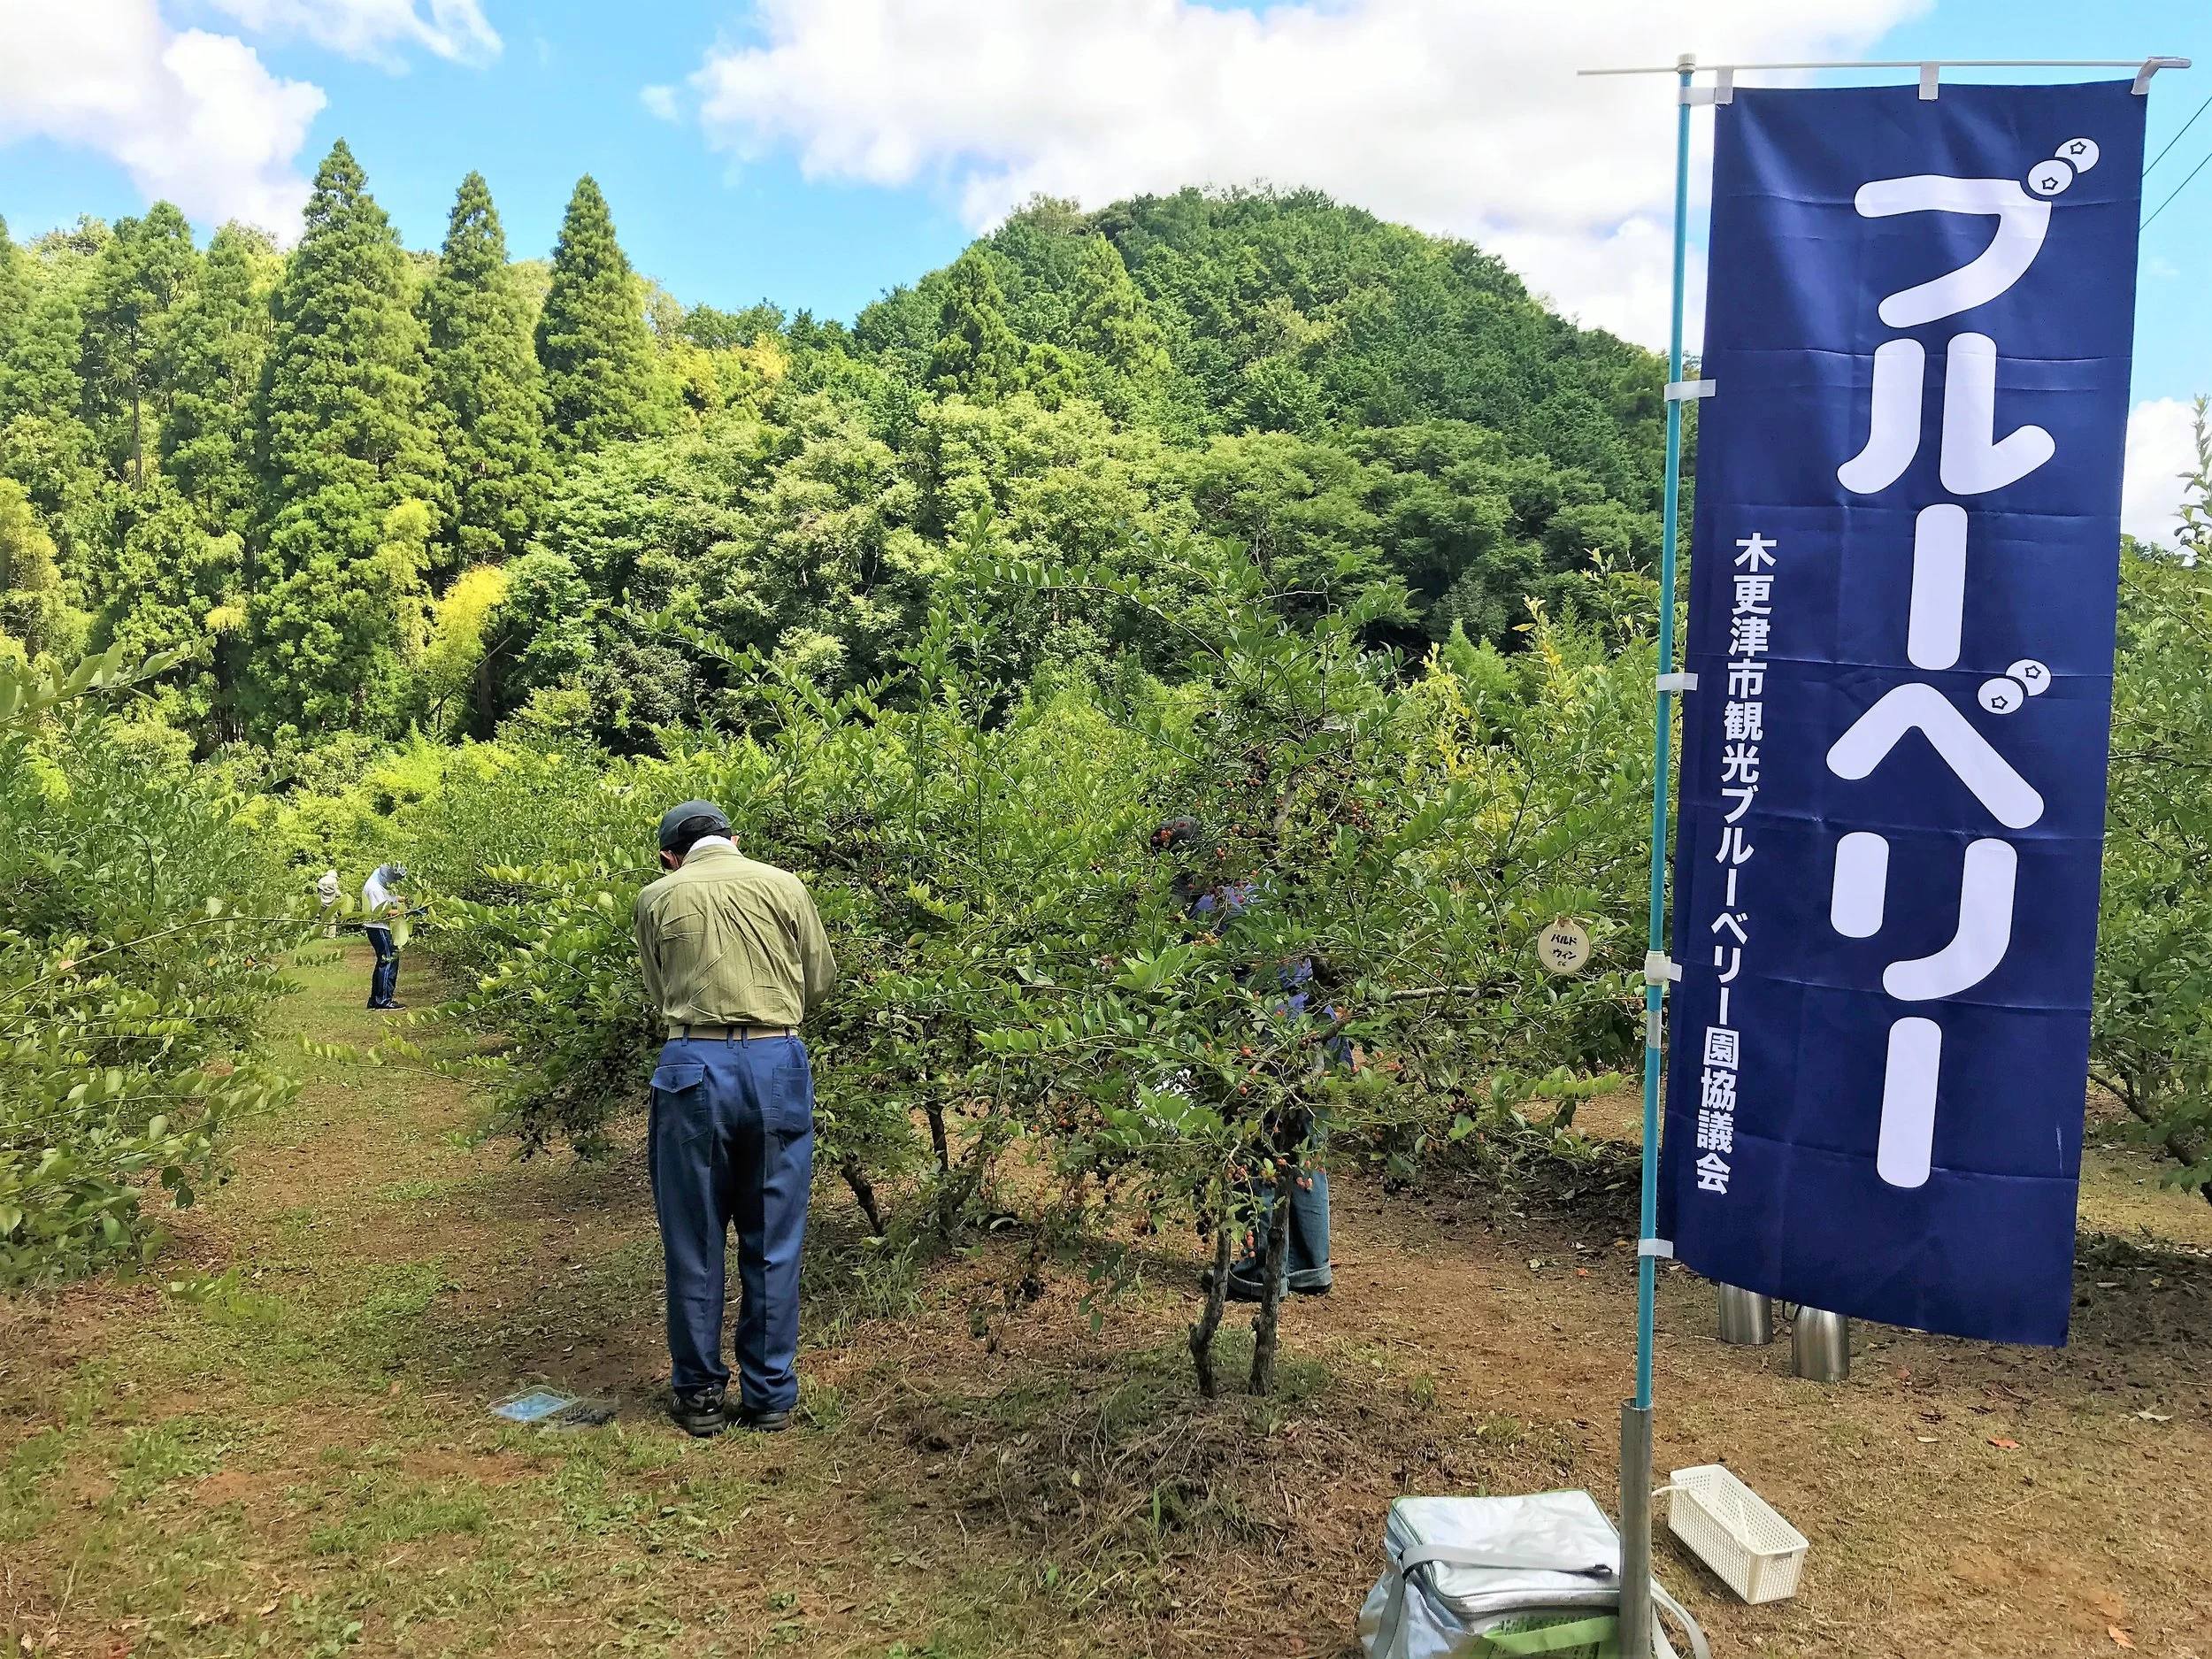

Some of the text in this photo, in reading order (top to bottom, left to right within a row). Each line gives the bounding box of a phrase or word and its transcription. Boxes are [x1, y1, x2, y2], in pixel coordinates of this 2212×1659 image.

[1695, 532, 1778, 1195] 木更津市観光ブルーベリー園協議会
[1825, 137, 2100, 1188] ブルーベリー
